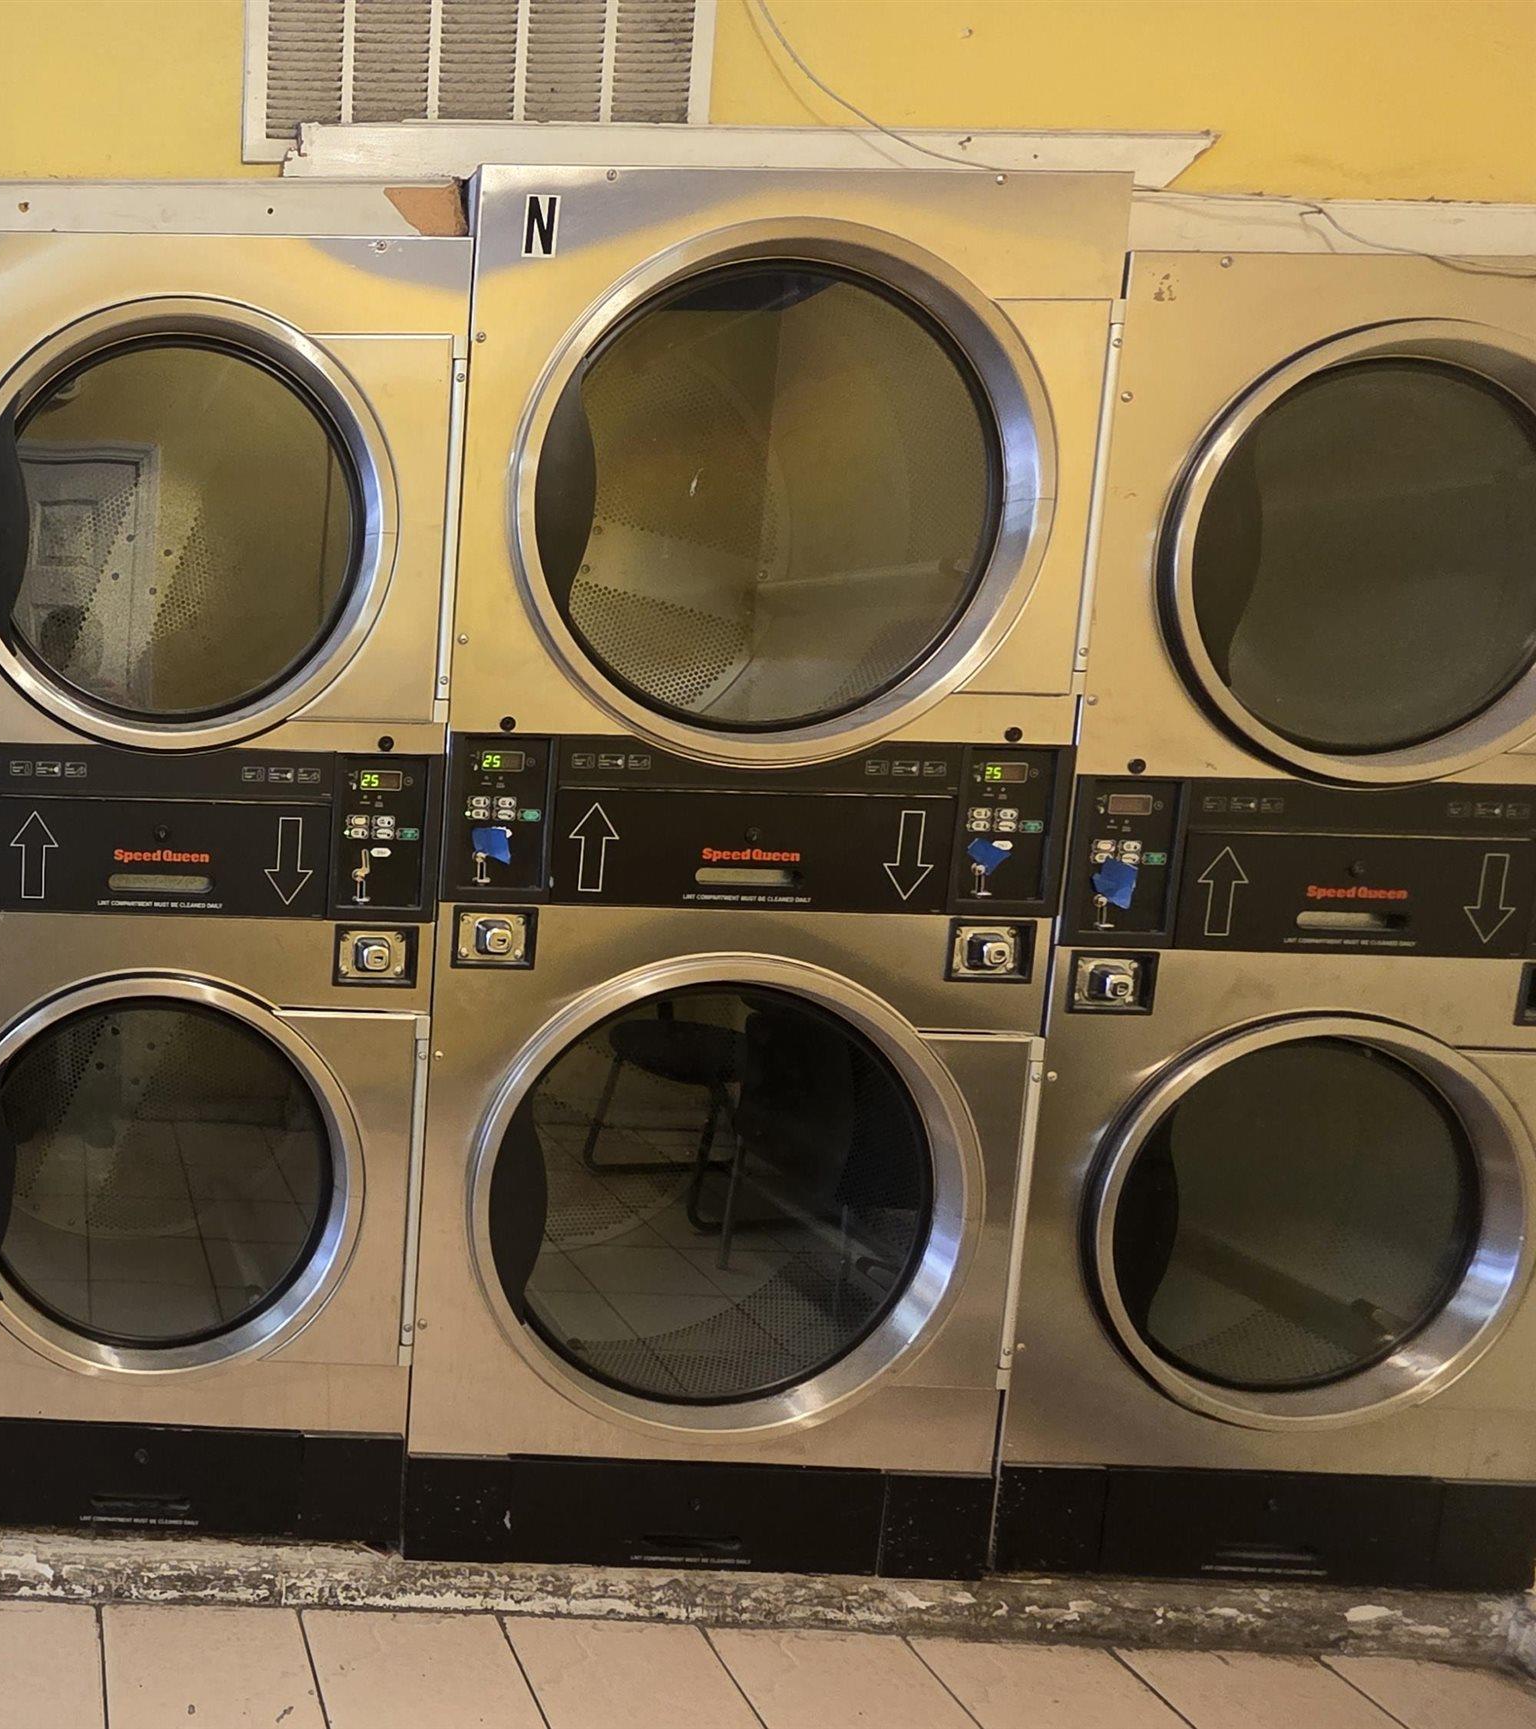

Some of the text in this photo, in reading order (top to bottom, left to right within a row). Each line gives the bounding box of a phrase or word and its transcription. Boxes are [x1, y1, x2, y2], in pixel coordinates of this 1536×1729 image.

[524, 196, 557, 255] N
[482, 755, 501, 768] 25
[985, 767, 1002, 779] 25
[361, 774, 379, 787] 25
[114, 849, 209, 863] Speed Queen
[702, 847, 800, 862] Speed Queen
[1306, 885, 1408, 900] Speed Queen
